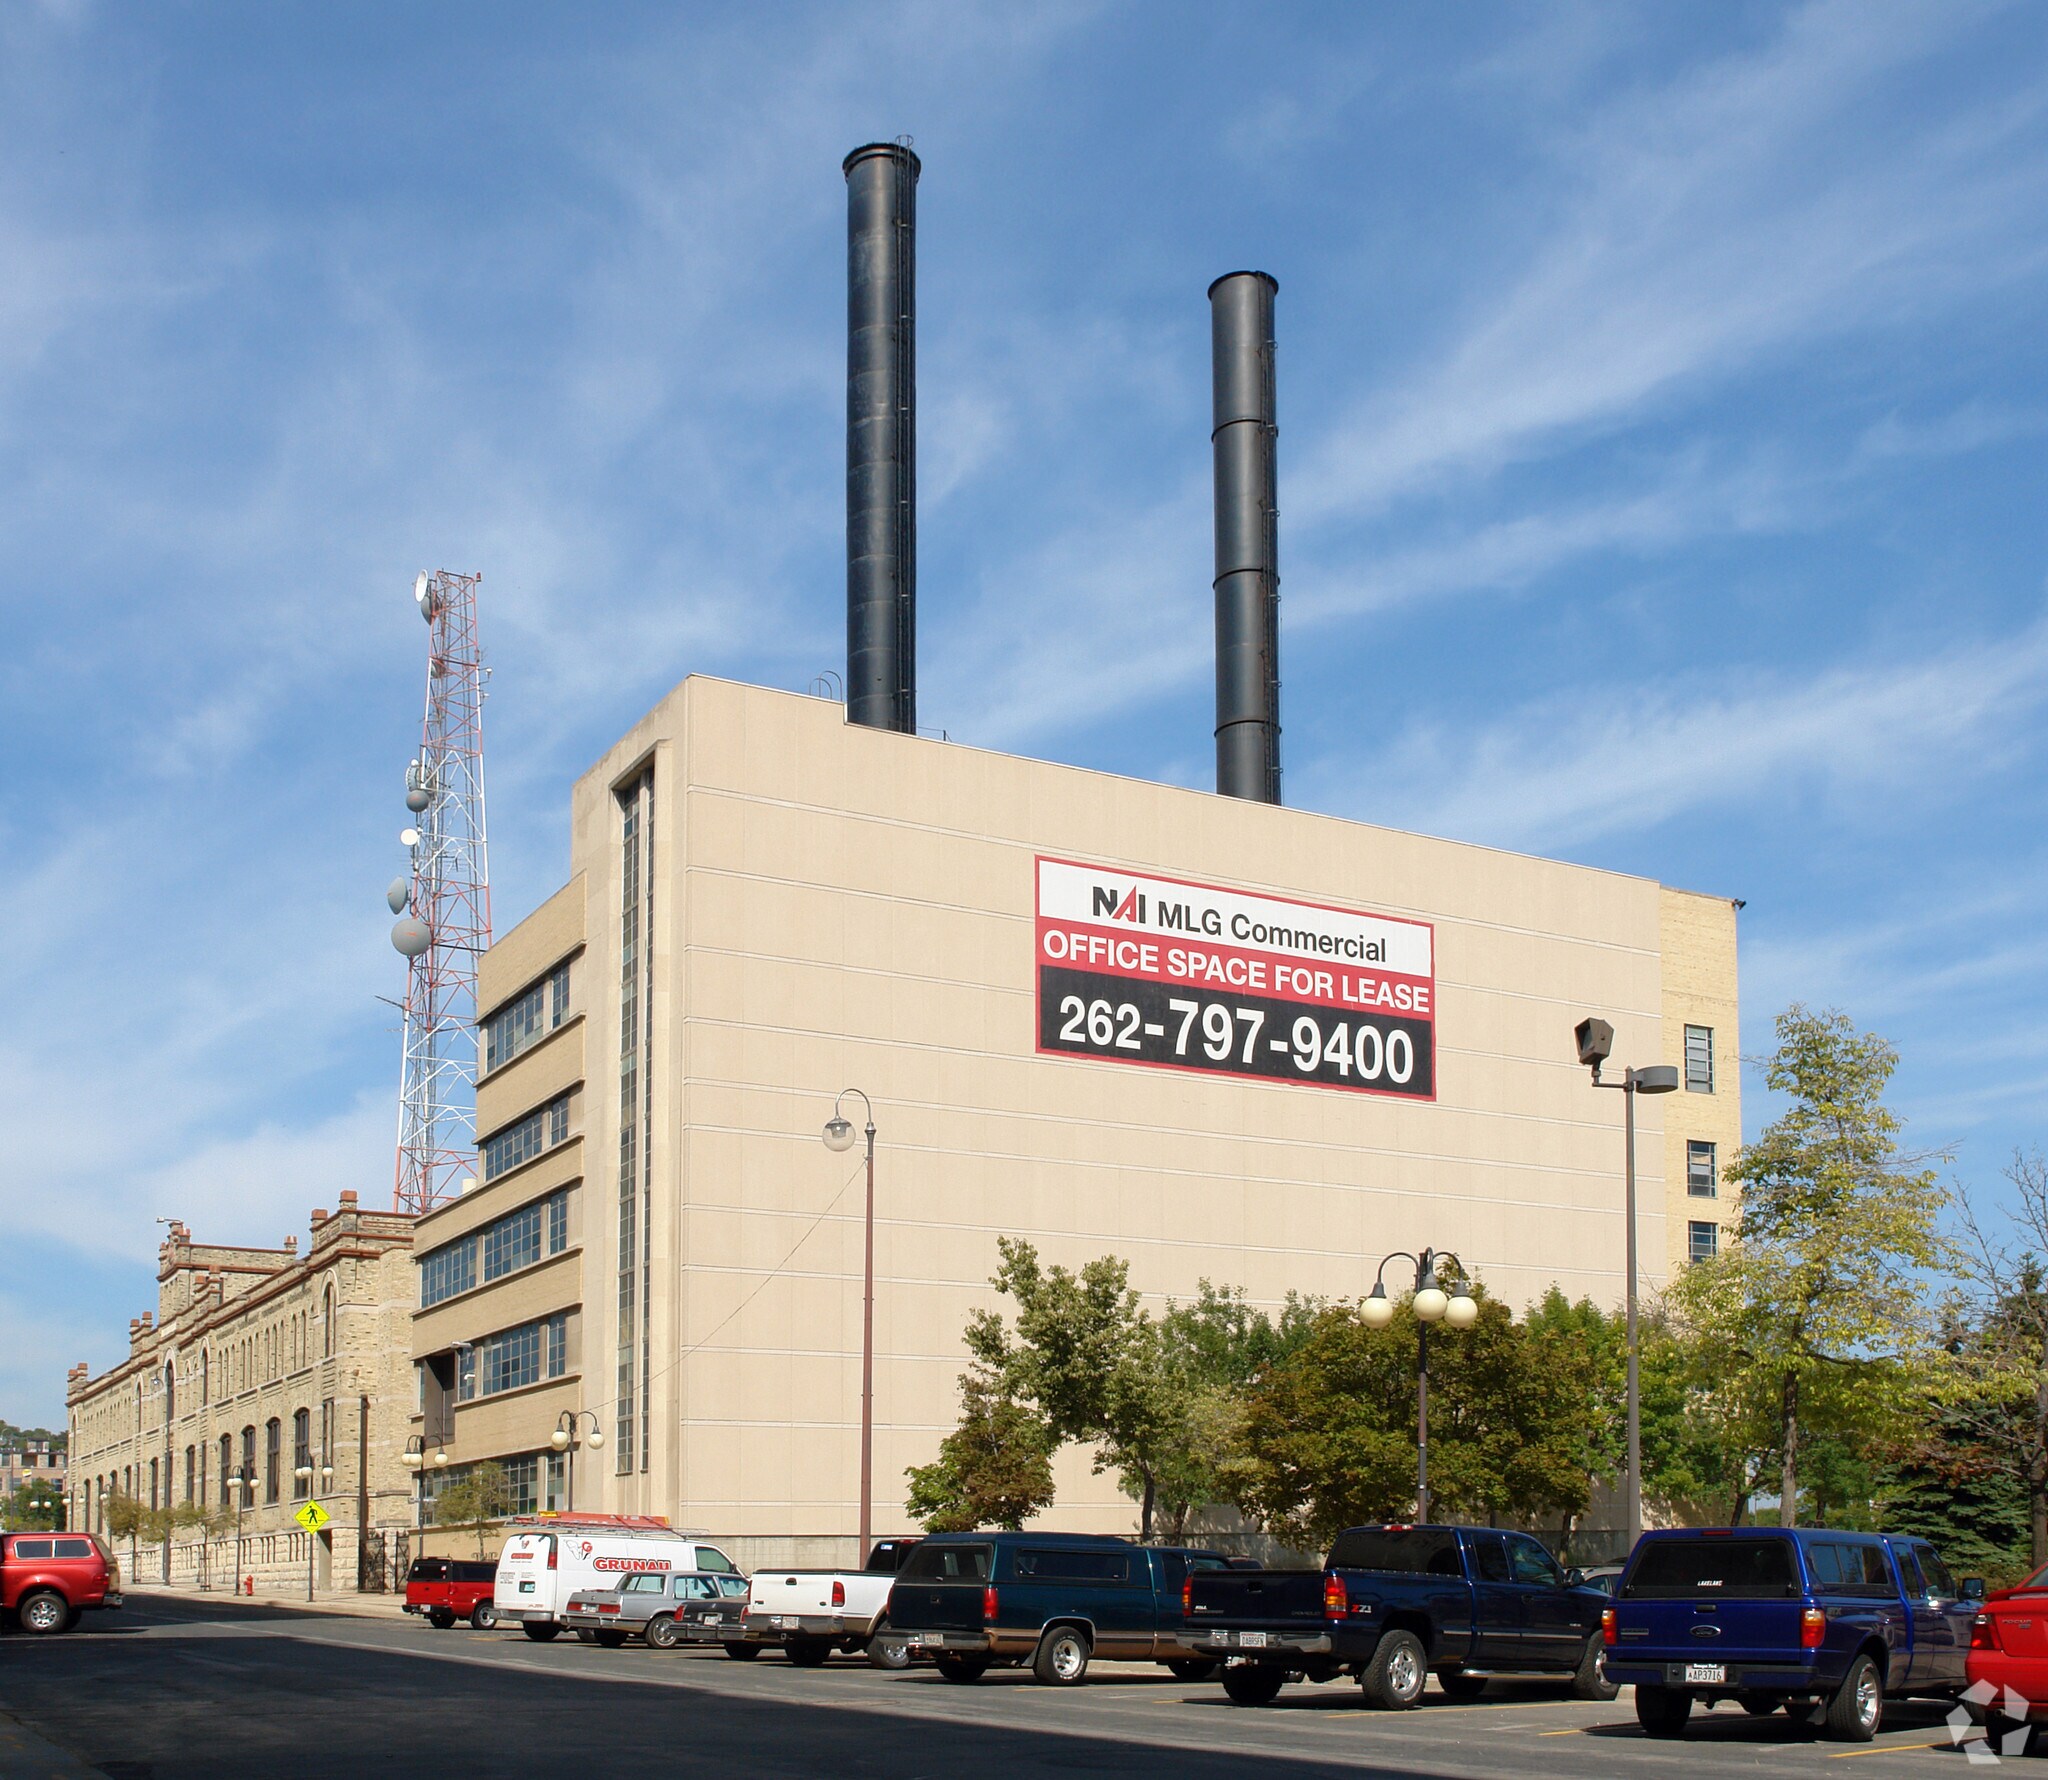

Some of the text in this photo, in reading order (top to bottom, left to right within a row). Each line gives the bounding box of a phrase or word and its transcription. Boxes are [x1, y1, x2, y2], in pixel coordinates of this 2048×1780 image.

[1093, 884, 1386, 962] NAI MLG Commercial
[1043, 929, 1430, 1013] OFFICE SPACE FOR LEASE
[1059, 994, 1414, 1084] 262-797-9400
[594, 1558, 671, 1571] GRUNAU
